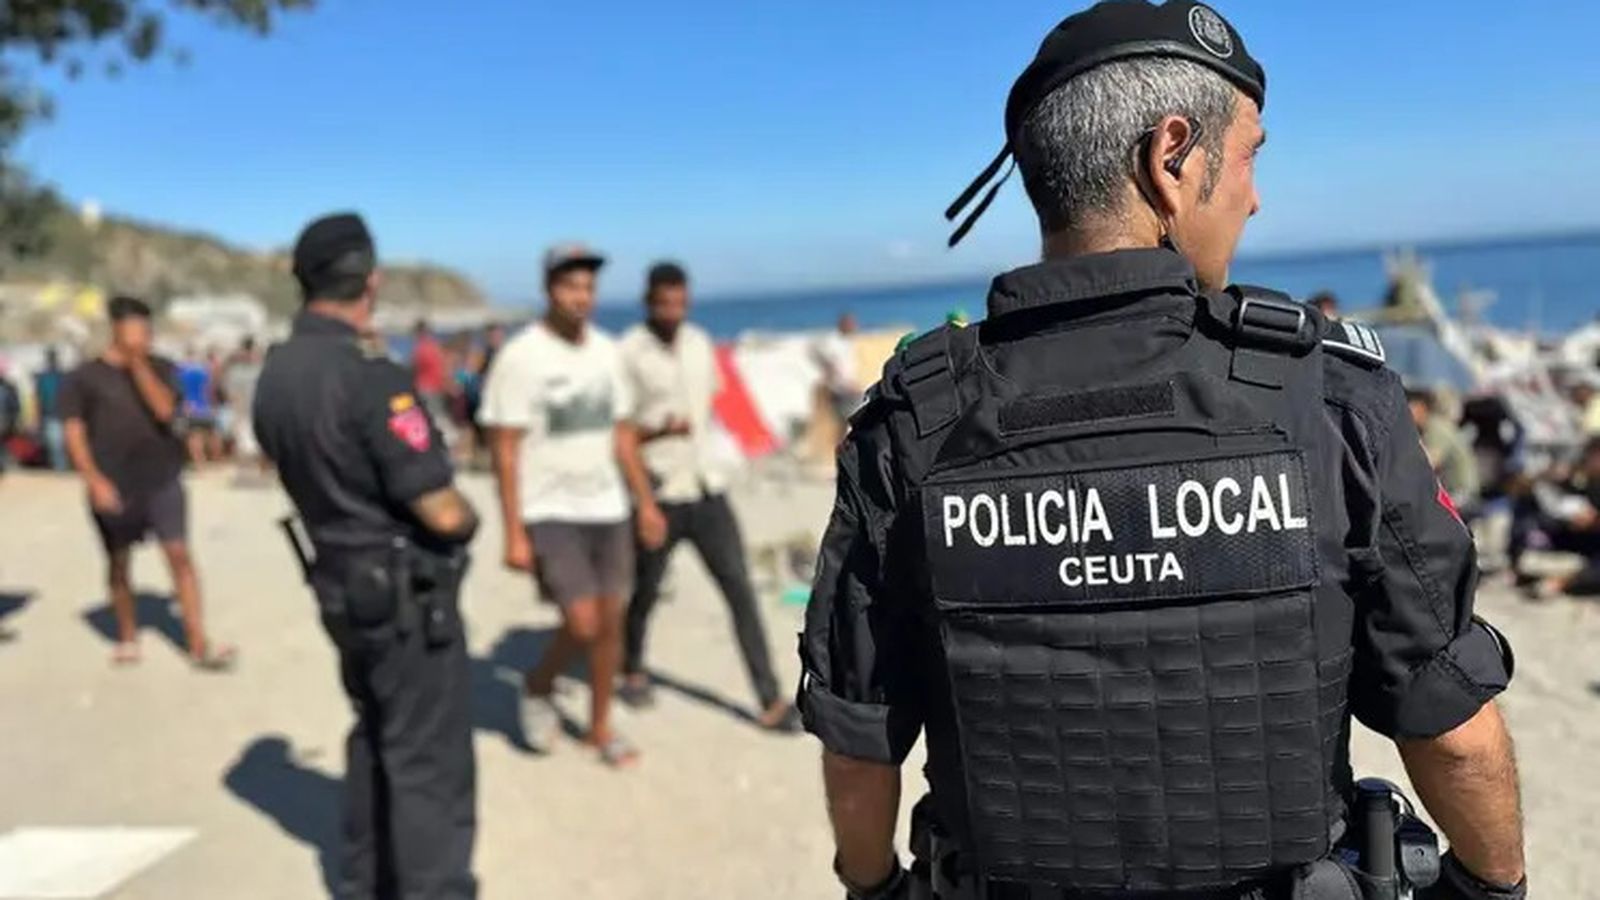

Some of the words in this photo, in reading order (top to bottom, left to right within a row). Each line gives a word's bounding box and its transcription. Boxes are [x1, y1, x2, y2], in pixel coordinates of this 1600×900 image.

[943, 488, 1113, 547] POLICIA
[1148, 473, 1308, 539] LOCAL
[1059, 551, 1184, 586] CEUTA
